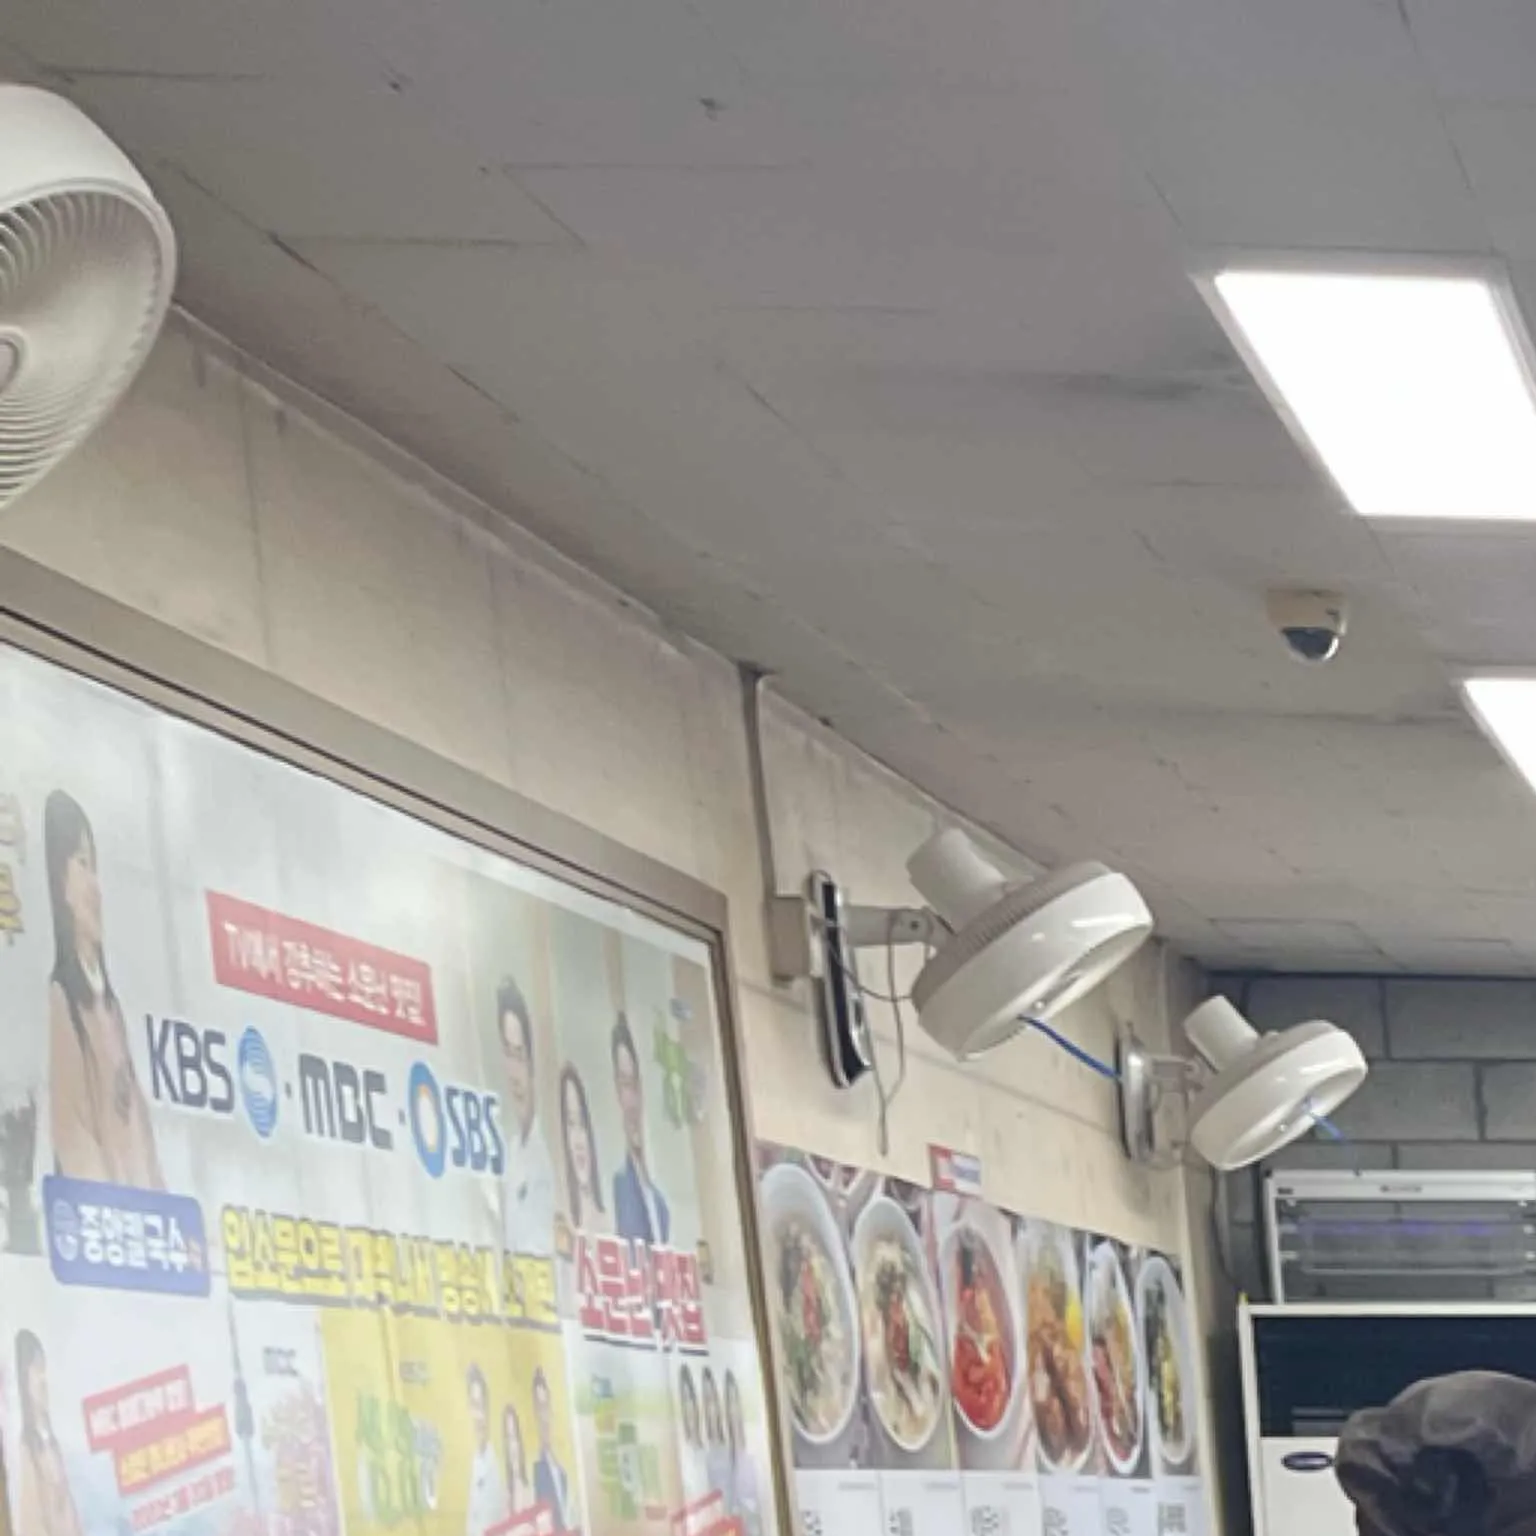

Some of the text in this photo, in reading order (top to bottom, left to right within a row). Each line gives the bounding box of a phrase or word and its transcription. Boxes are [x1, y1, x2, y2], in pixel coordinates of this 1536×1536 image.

[146, 1013, 505, 1175] KBS MBC SBS
[78, 1203, 188, 1274] 중앙칼국수
[222, 1204, 344, 1298] 입소문으로
[577, 1230, 656, 1345] 소문난
